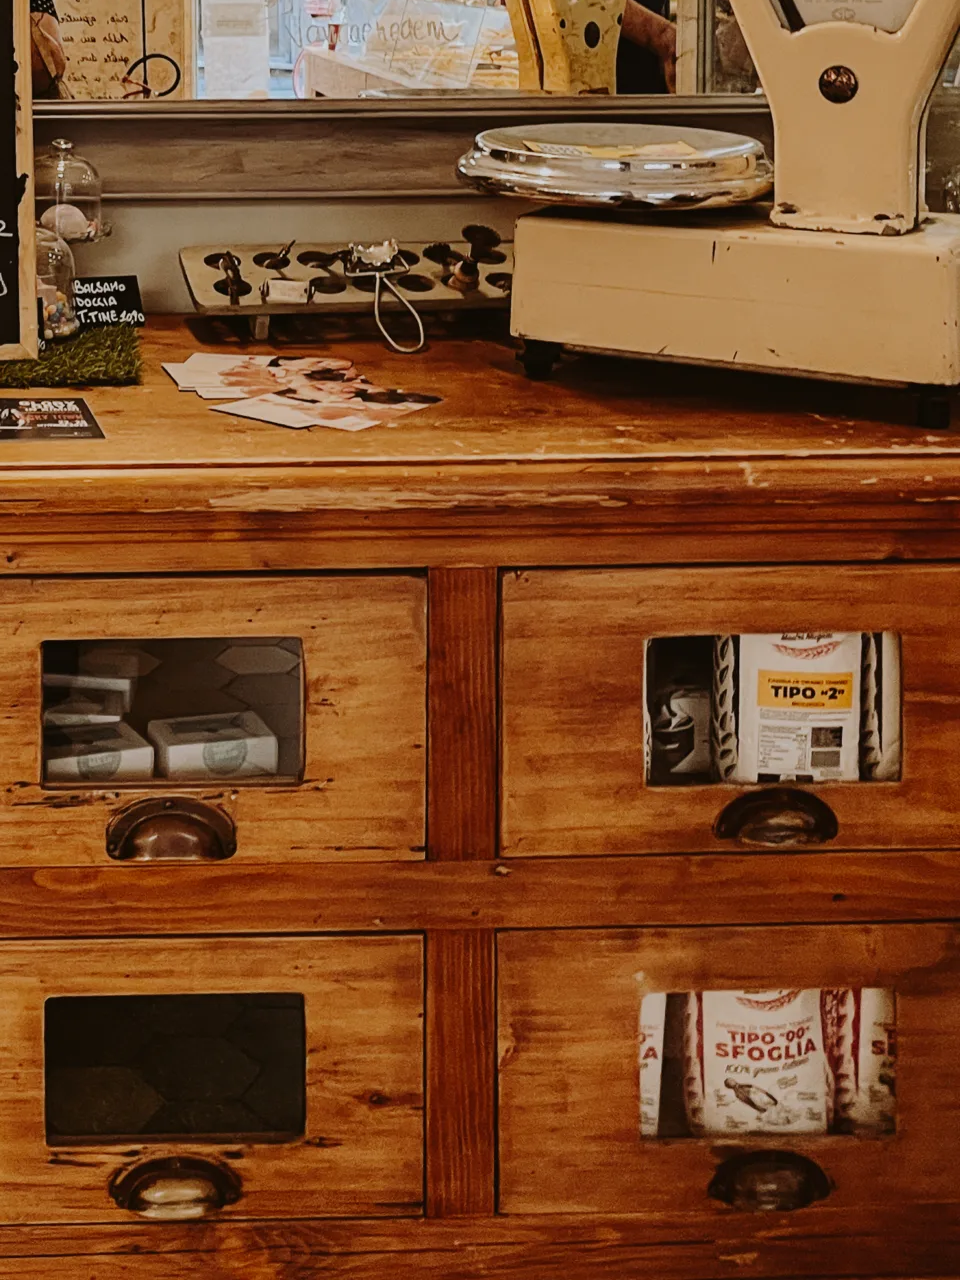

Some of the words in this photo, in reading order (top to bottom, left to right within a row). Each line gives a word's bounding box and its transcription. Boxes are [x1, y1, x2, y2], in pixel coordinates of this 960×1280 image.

[74, 280, 126, 294] BALSAMO
[771, 685, 816, 699] TIPO
[727, 1029, 775, 1045] TIPO
[715, 1039, 817, 1061] SFOGLIA
